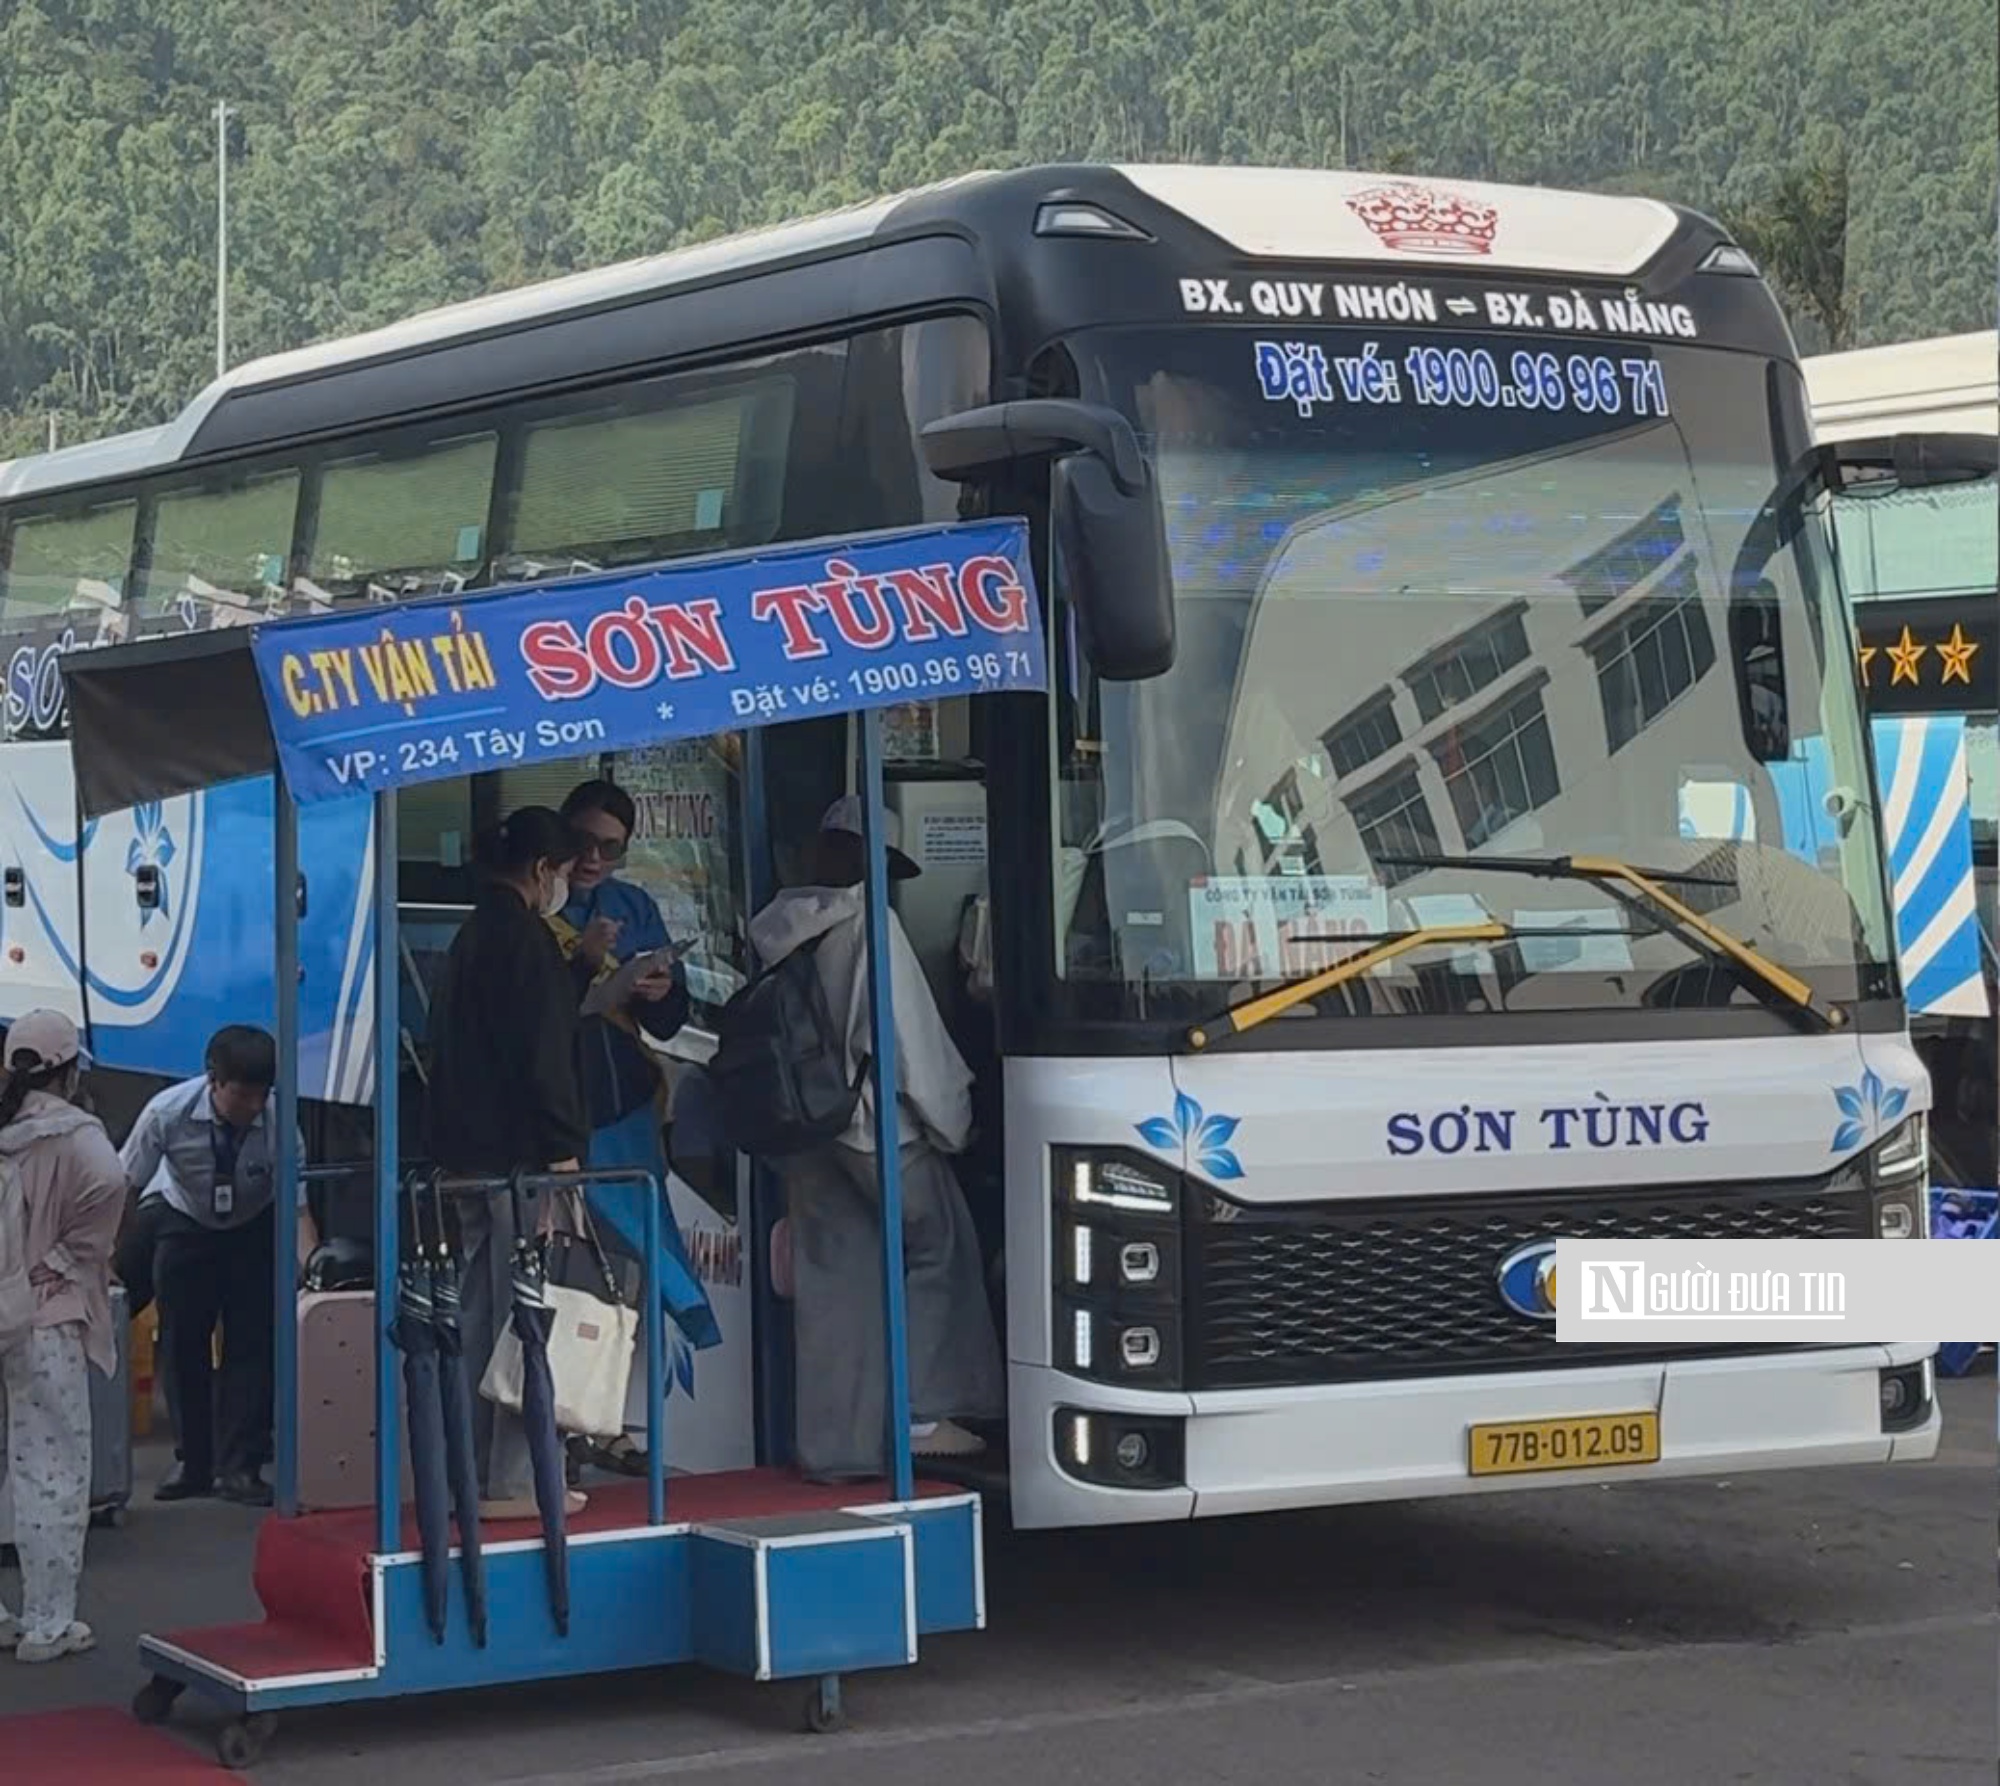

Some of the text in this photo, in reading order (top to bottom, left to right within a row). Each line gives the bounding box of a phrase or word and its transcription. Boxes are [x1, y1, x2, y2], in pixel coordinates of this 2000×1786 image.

[1179, 279, 1697, 337] BX. QUY NHƠN BX. ĐÀ NẴNG
[1254, 341, 1669, 417] Đặt vé: 1900.96 96 71
[519, 556, 1030, 700] SƠN TÙNG
[282, 609, 496, 718] C.TY VẬN TẢI
[730, 650, 1032, 718] Đặt vé: 1900.96 96 71
[326, 717, 605, 785] VP: 234 Tây Sơn
[1387, 1091, 1709, 1155] SƠN TÙNG
[1487, 1423, 1643, 1465] 77B-012.09
